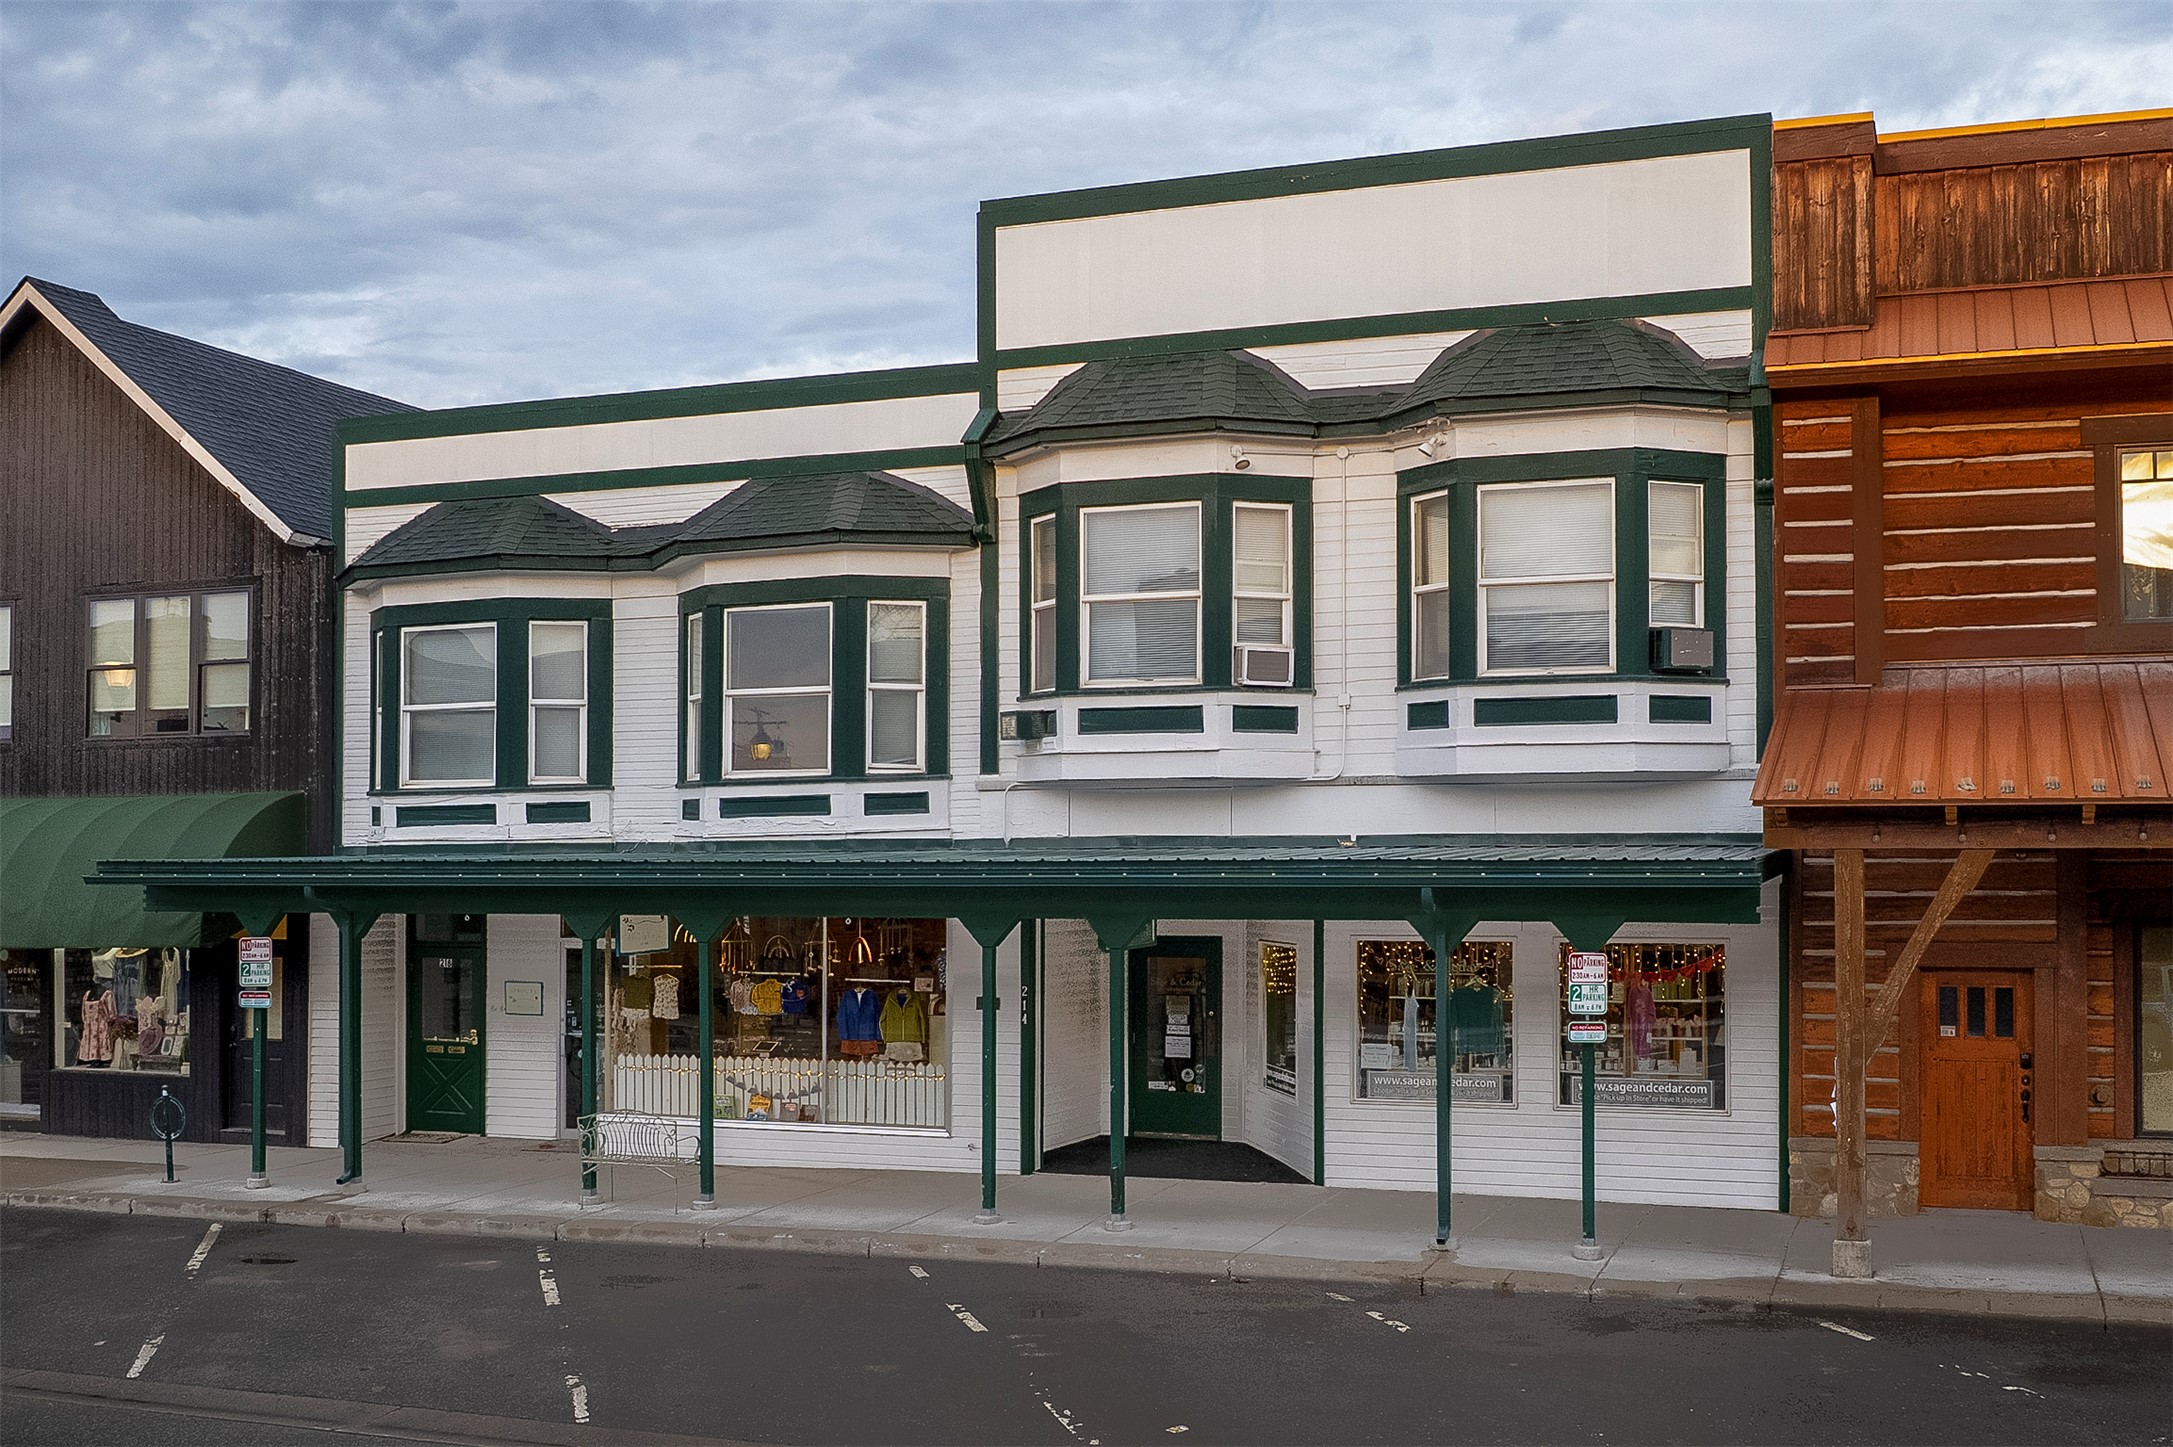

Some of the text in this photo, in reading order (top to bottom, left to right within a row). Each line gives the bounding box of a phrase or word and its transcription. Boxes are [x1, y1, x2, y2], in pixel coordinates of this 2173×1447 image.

[242, 940, 251, 950] NO
[1571, 956, 1604, 969] NO PARKING
[242, 964, 250, 976] 2
[1572, 985, 1598, 1001] 2 HR
